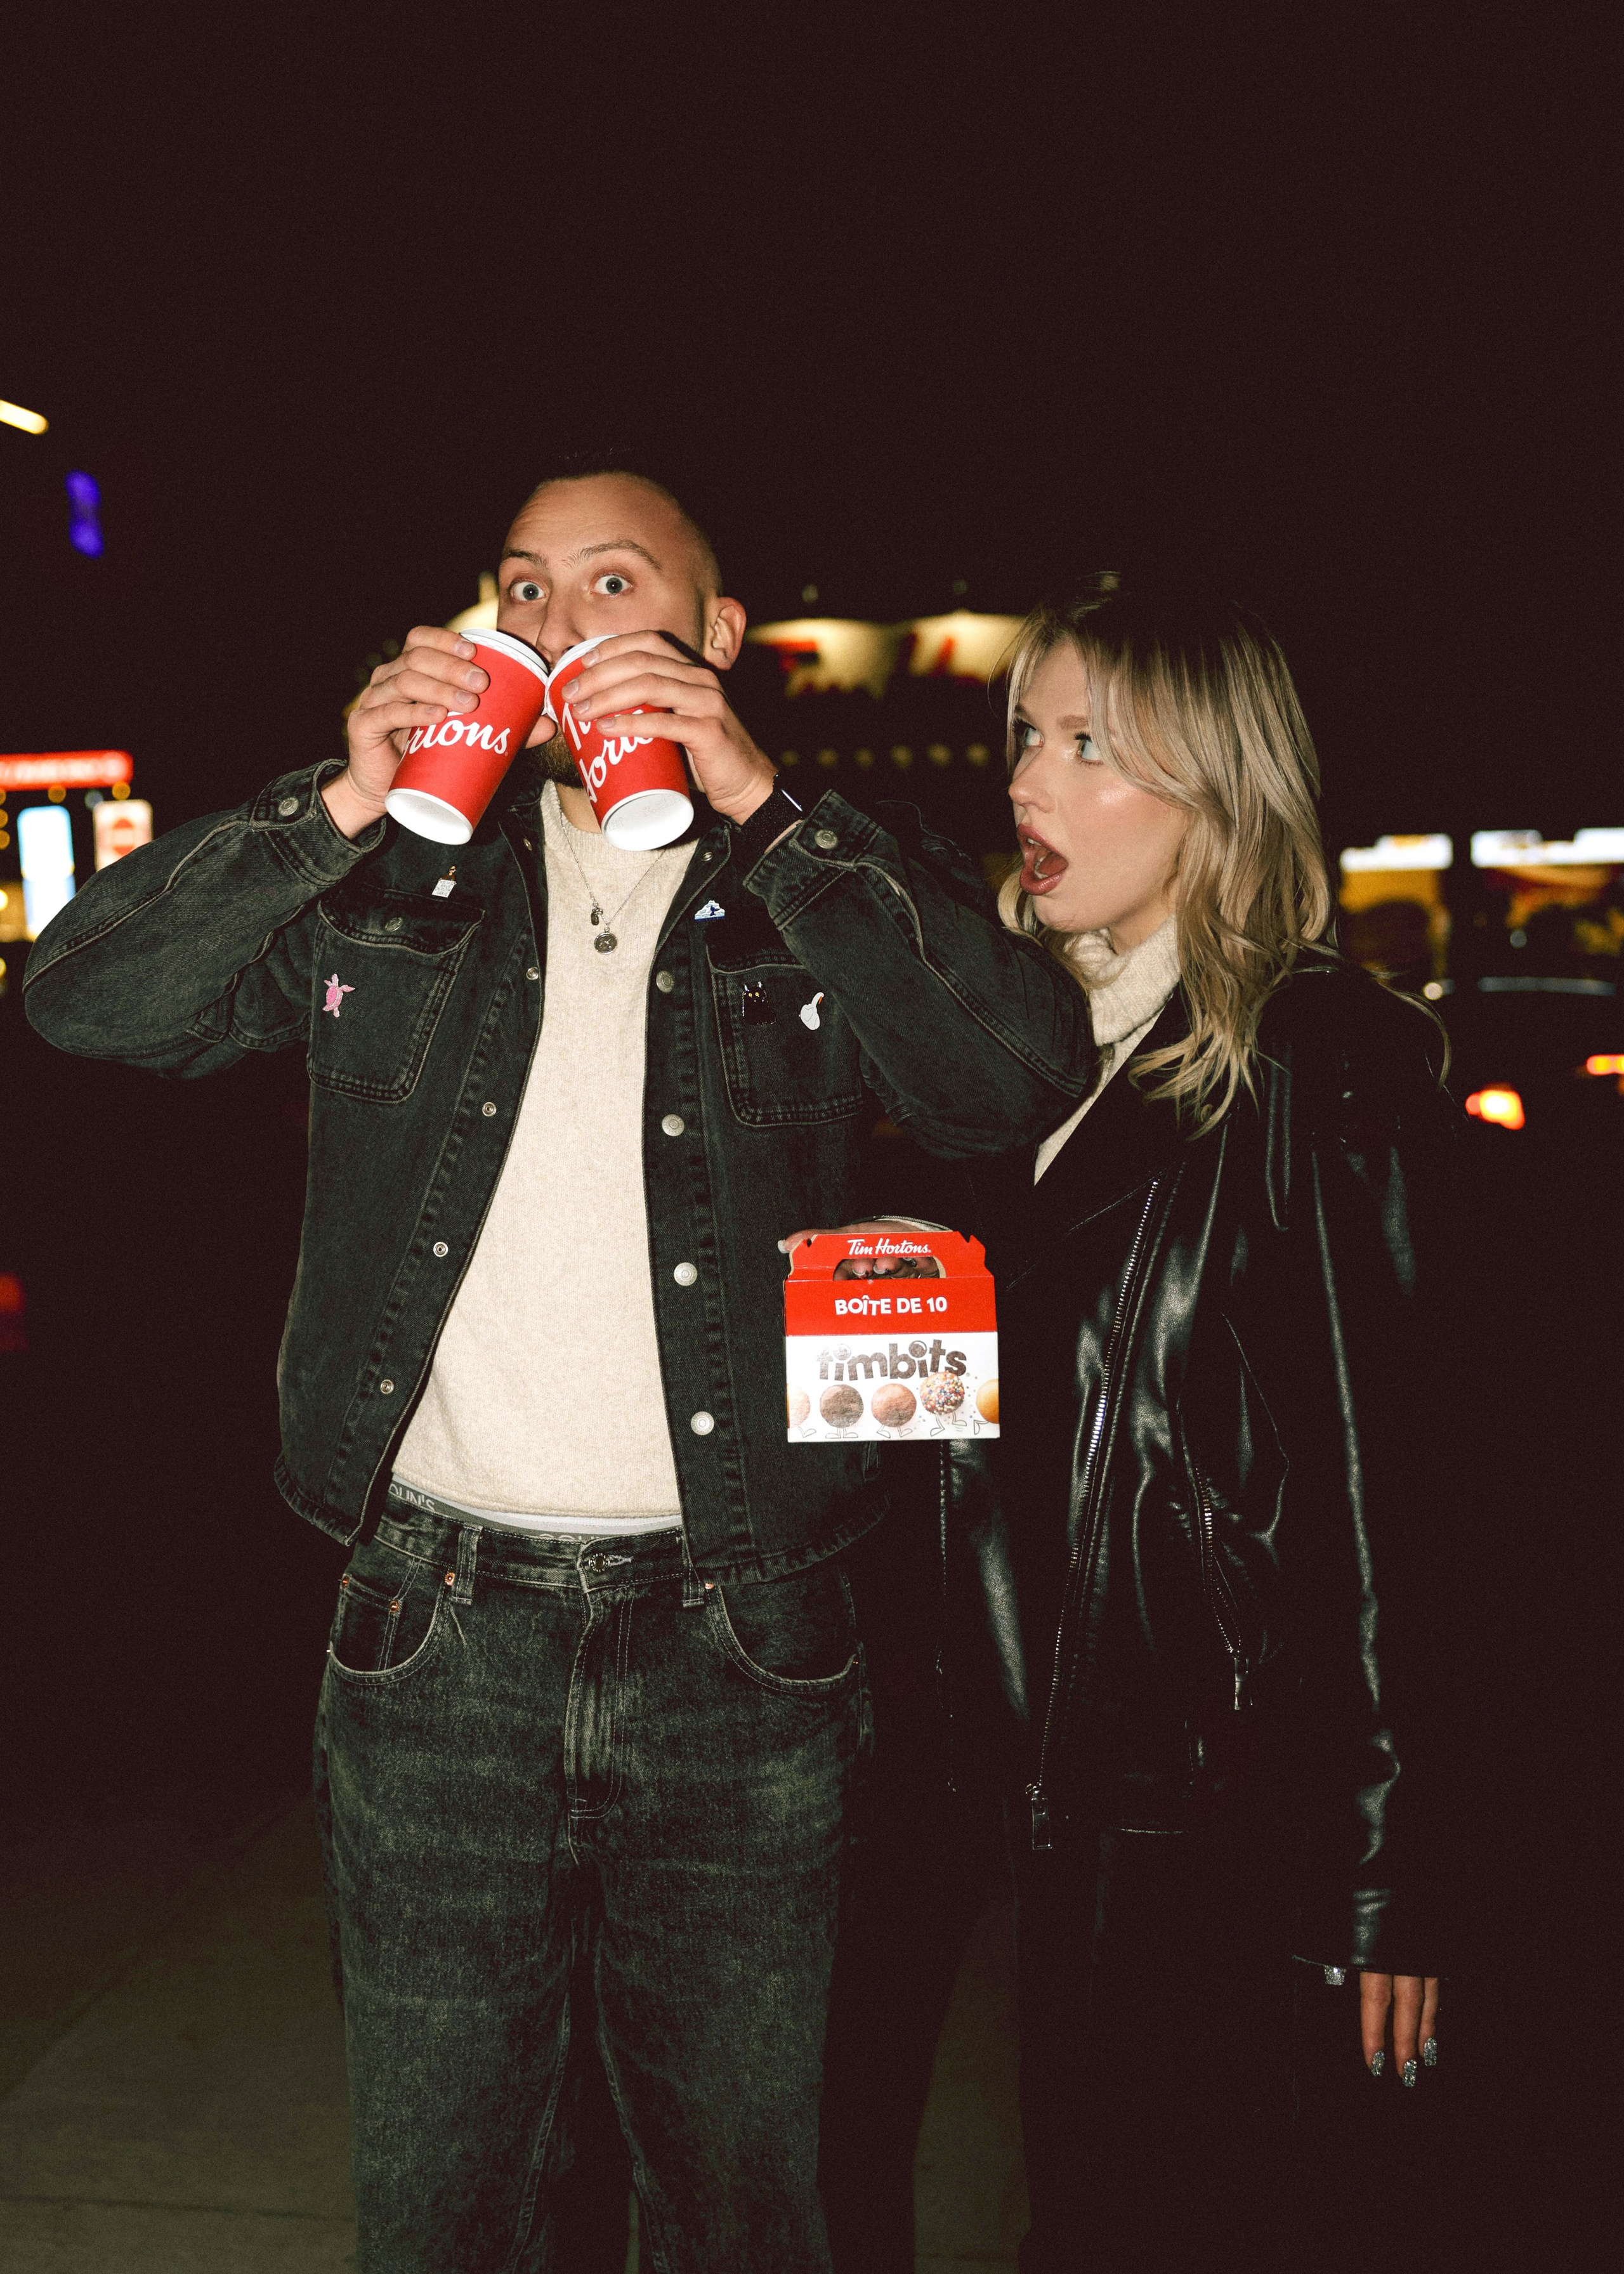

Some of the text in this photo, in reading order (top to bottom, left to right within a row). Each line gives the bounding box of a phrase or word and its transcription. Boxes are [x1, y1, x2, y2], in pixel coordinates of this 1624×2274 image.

[847, 1238, 929, 1255] Tim Hortons
[834, 1295, 948, 1316] BOÎTE DE 10
[816, 1339, 967, 1382] timbits
